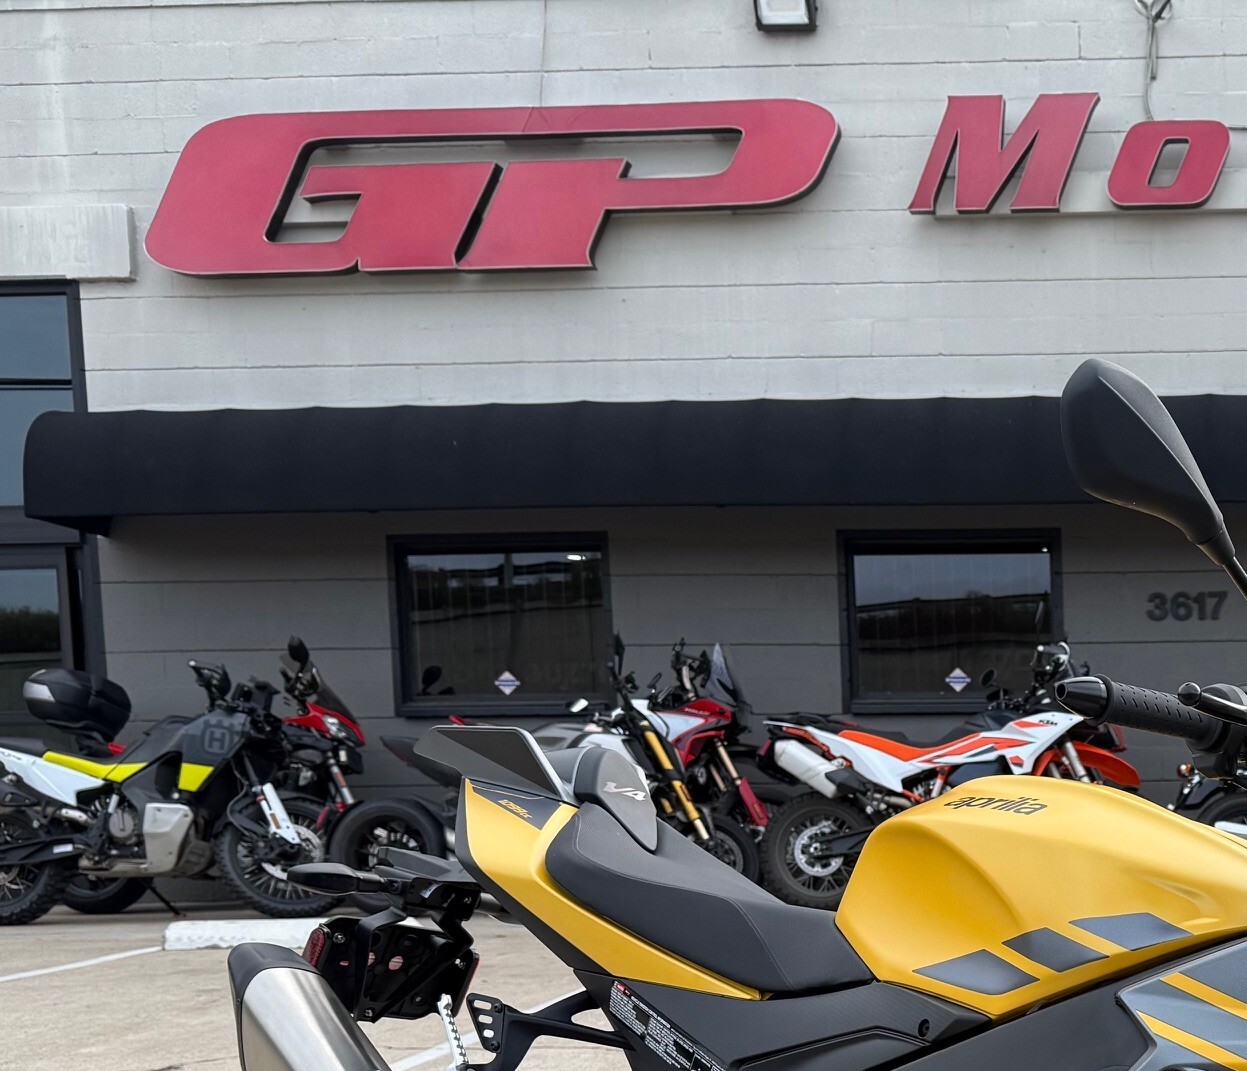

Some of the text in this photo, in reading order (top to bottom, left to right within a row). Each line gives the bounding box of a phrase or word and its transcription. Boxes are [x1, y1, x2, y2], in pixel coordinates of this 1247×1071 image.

[144, 98, 842, 276] GP
[1146, 591, 1228, 622] 3617
[603, 781, 646, 801] V4
[943, 796, 1048, 815] aprilia
